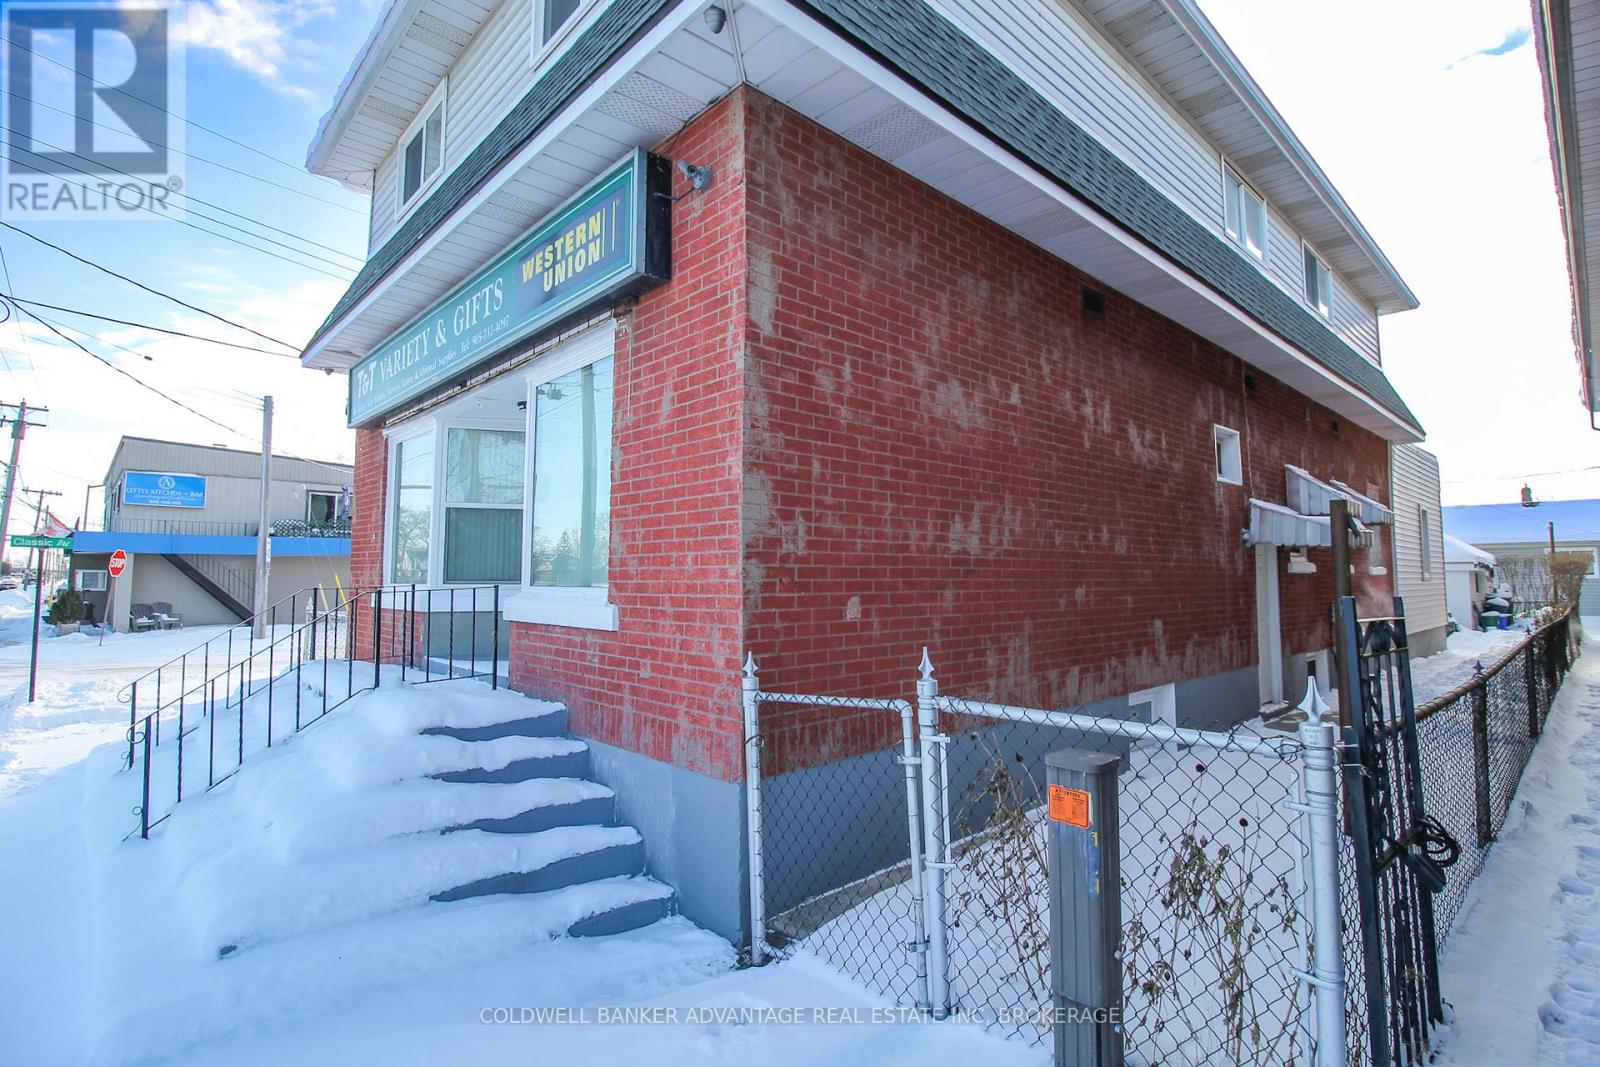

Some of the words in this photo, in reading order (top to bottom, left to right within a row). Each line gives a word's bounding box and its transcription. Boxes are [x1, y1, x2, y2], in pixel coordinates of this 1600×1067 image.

[522, 211, 602, 284] WESTERN
[543, 237, 601, 293] UNION
[357, 360, 377, 397] T&T
[378, 327, 431, 381] VARIETY
[435, 319, 447, 348] &
[453, 278, 504, 336] GIFTS
[13, 536, 53, 547] Classic
[56, 538, 71, 547] Av
[110, 557, 126, 569] STOP
